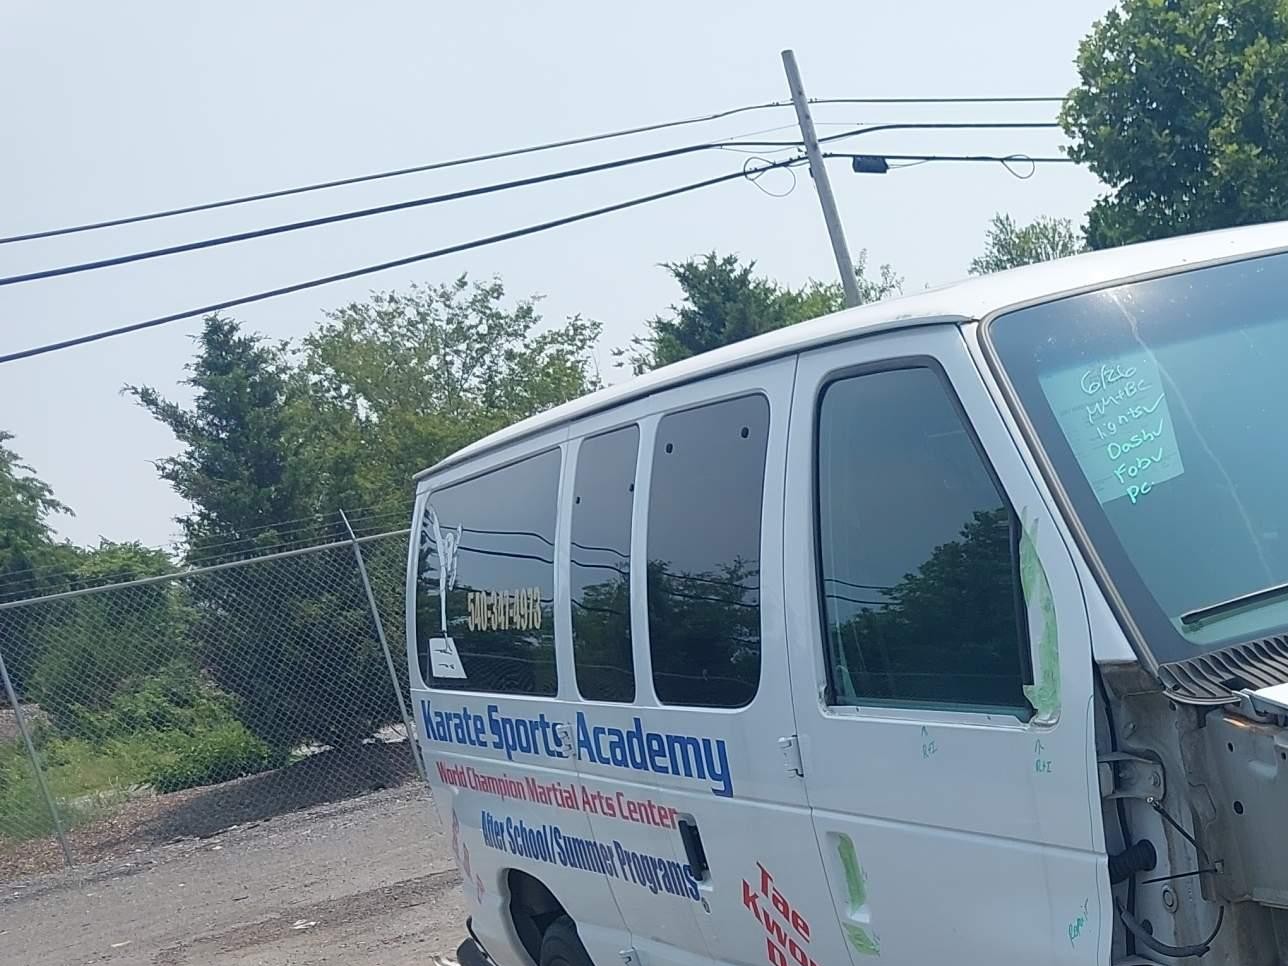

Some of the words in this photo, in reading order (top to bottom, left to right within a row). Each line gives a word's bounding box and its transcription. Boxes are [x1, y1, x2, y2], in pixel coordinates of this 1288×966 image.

[421, 699, 488, 748] Karate
[487, 704, 570, 761] Sports
[576, 711, 734, 798] Academy
[436, 760, 469, 789] World
[466, 766, 527, 801] Champion
[523, 776, 581, 811] Martial
[580, 785, 617, 818] Arts
[615, 792, 679, 830] Center
[481, 810, 508, 852] After
[612, 840, 702, 901] Programs
[756, 861, 811, 944] Tae
